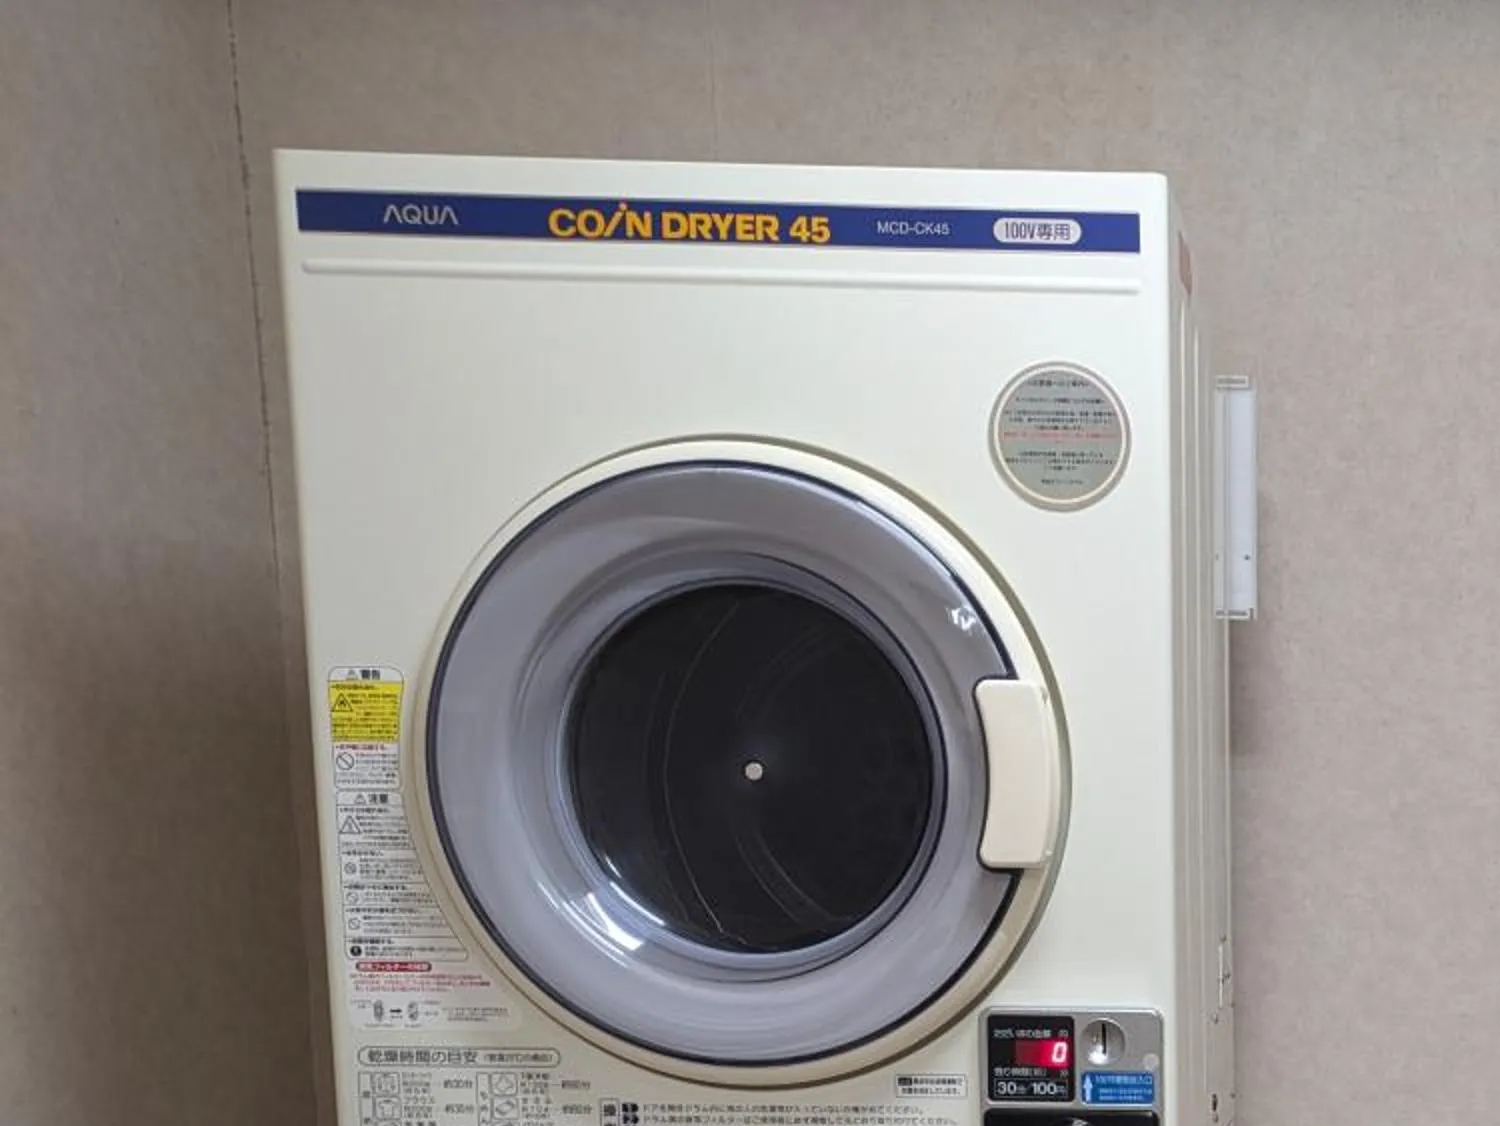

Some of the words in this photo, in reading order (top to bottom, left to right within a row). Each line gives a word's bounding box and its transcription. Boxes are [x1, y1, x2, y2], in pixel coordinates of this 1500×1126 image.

[383, 204, 459, 226] AQUA
[549, 201, 652, 241] COIN
[661, 208, 780, 242] DRYER
[789, 216, 832, 245] 45
[876, 220, 951, 236] MCD-CK45
[1002, 221, 1073, 242] 100V専用
[368, 1049, 478, 1063] 乾燥時間の目安
[1051, 1041, 1068, 1063] 0
